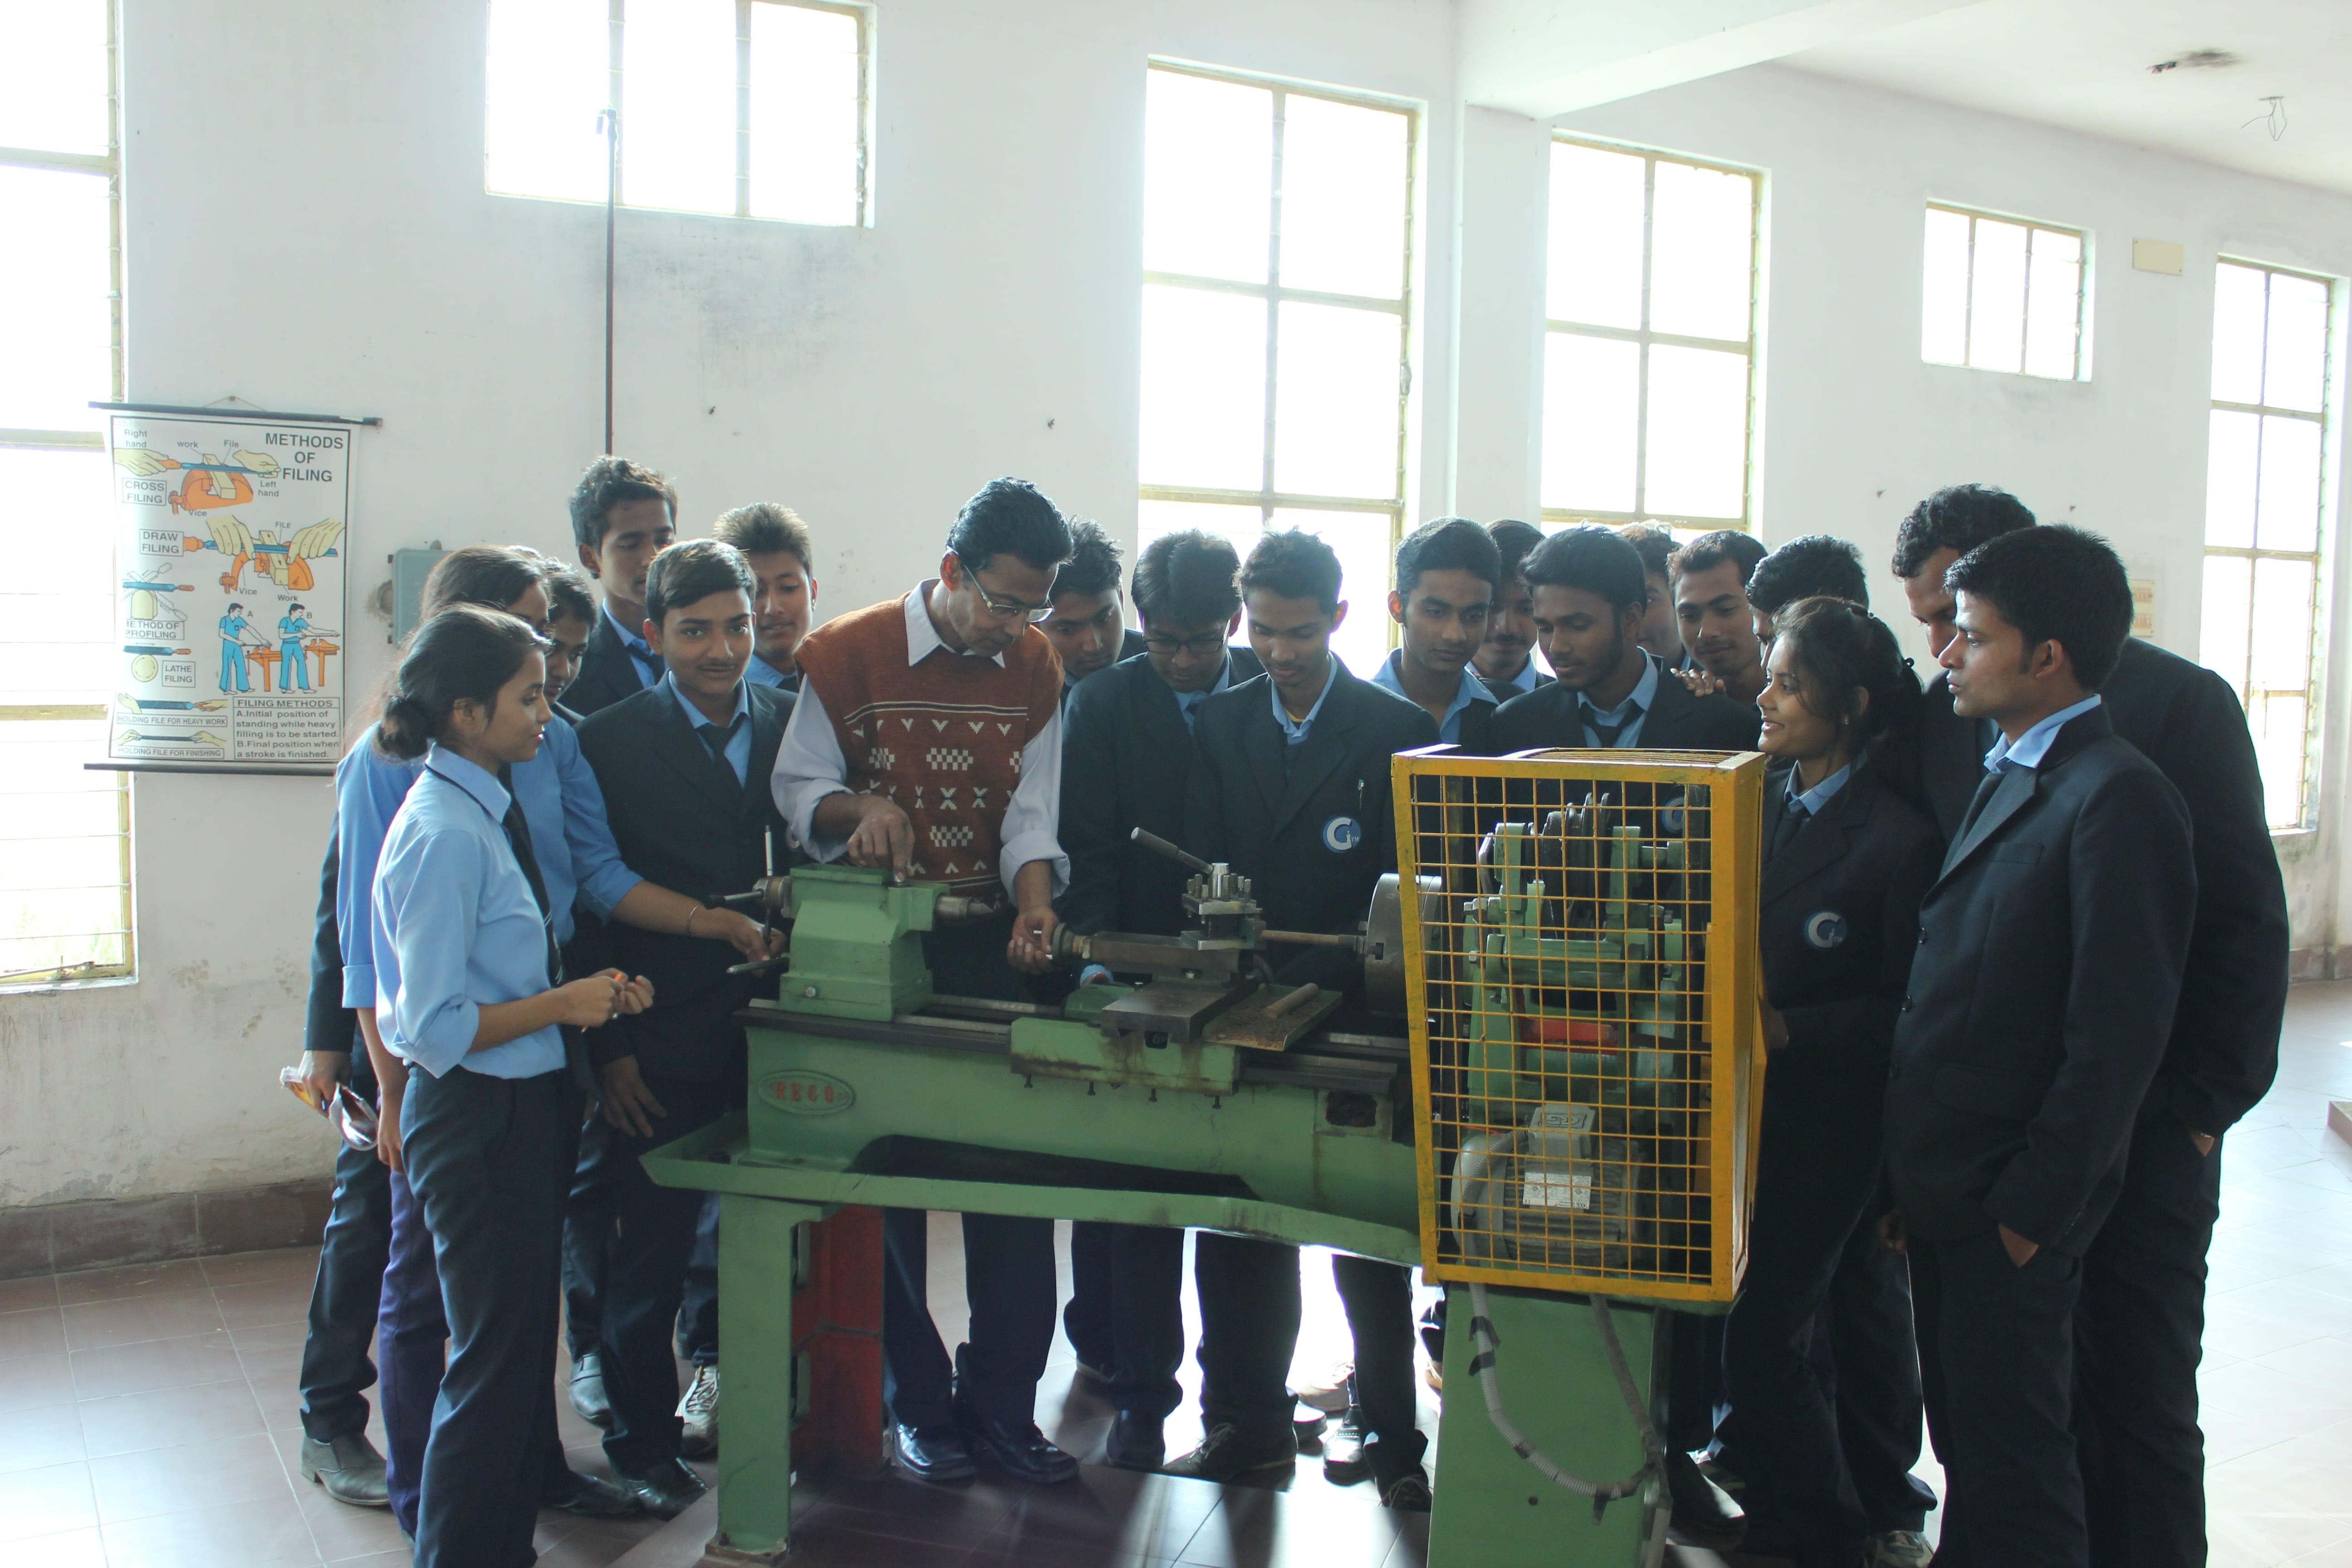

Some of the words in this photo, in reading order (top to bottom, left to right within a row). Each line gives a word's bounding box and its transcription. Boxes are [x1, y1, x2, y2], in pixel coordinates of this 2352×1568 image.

[124, 429, 147, 439] Right
[224, 440, 239, 448] File
[265, 433, 343, 449] METHODS
[294, 451, 315, 464] OF
[283, 468, 332, 482] FILING
[125, 481, 164, 491] CROSS
[127, 493, 162, 504] FILING
[143, 532, 178, 541] DRAW
[142, 544, 179, 554] FILING
[126, 630, 176, 638] PROFILING
